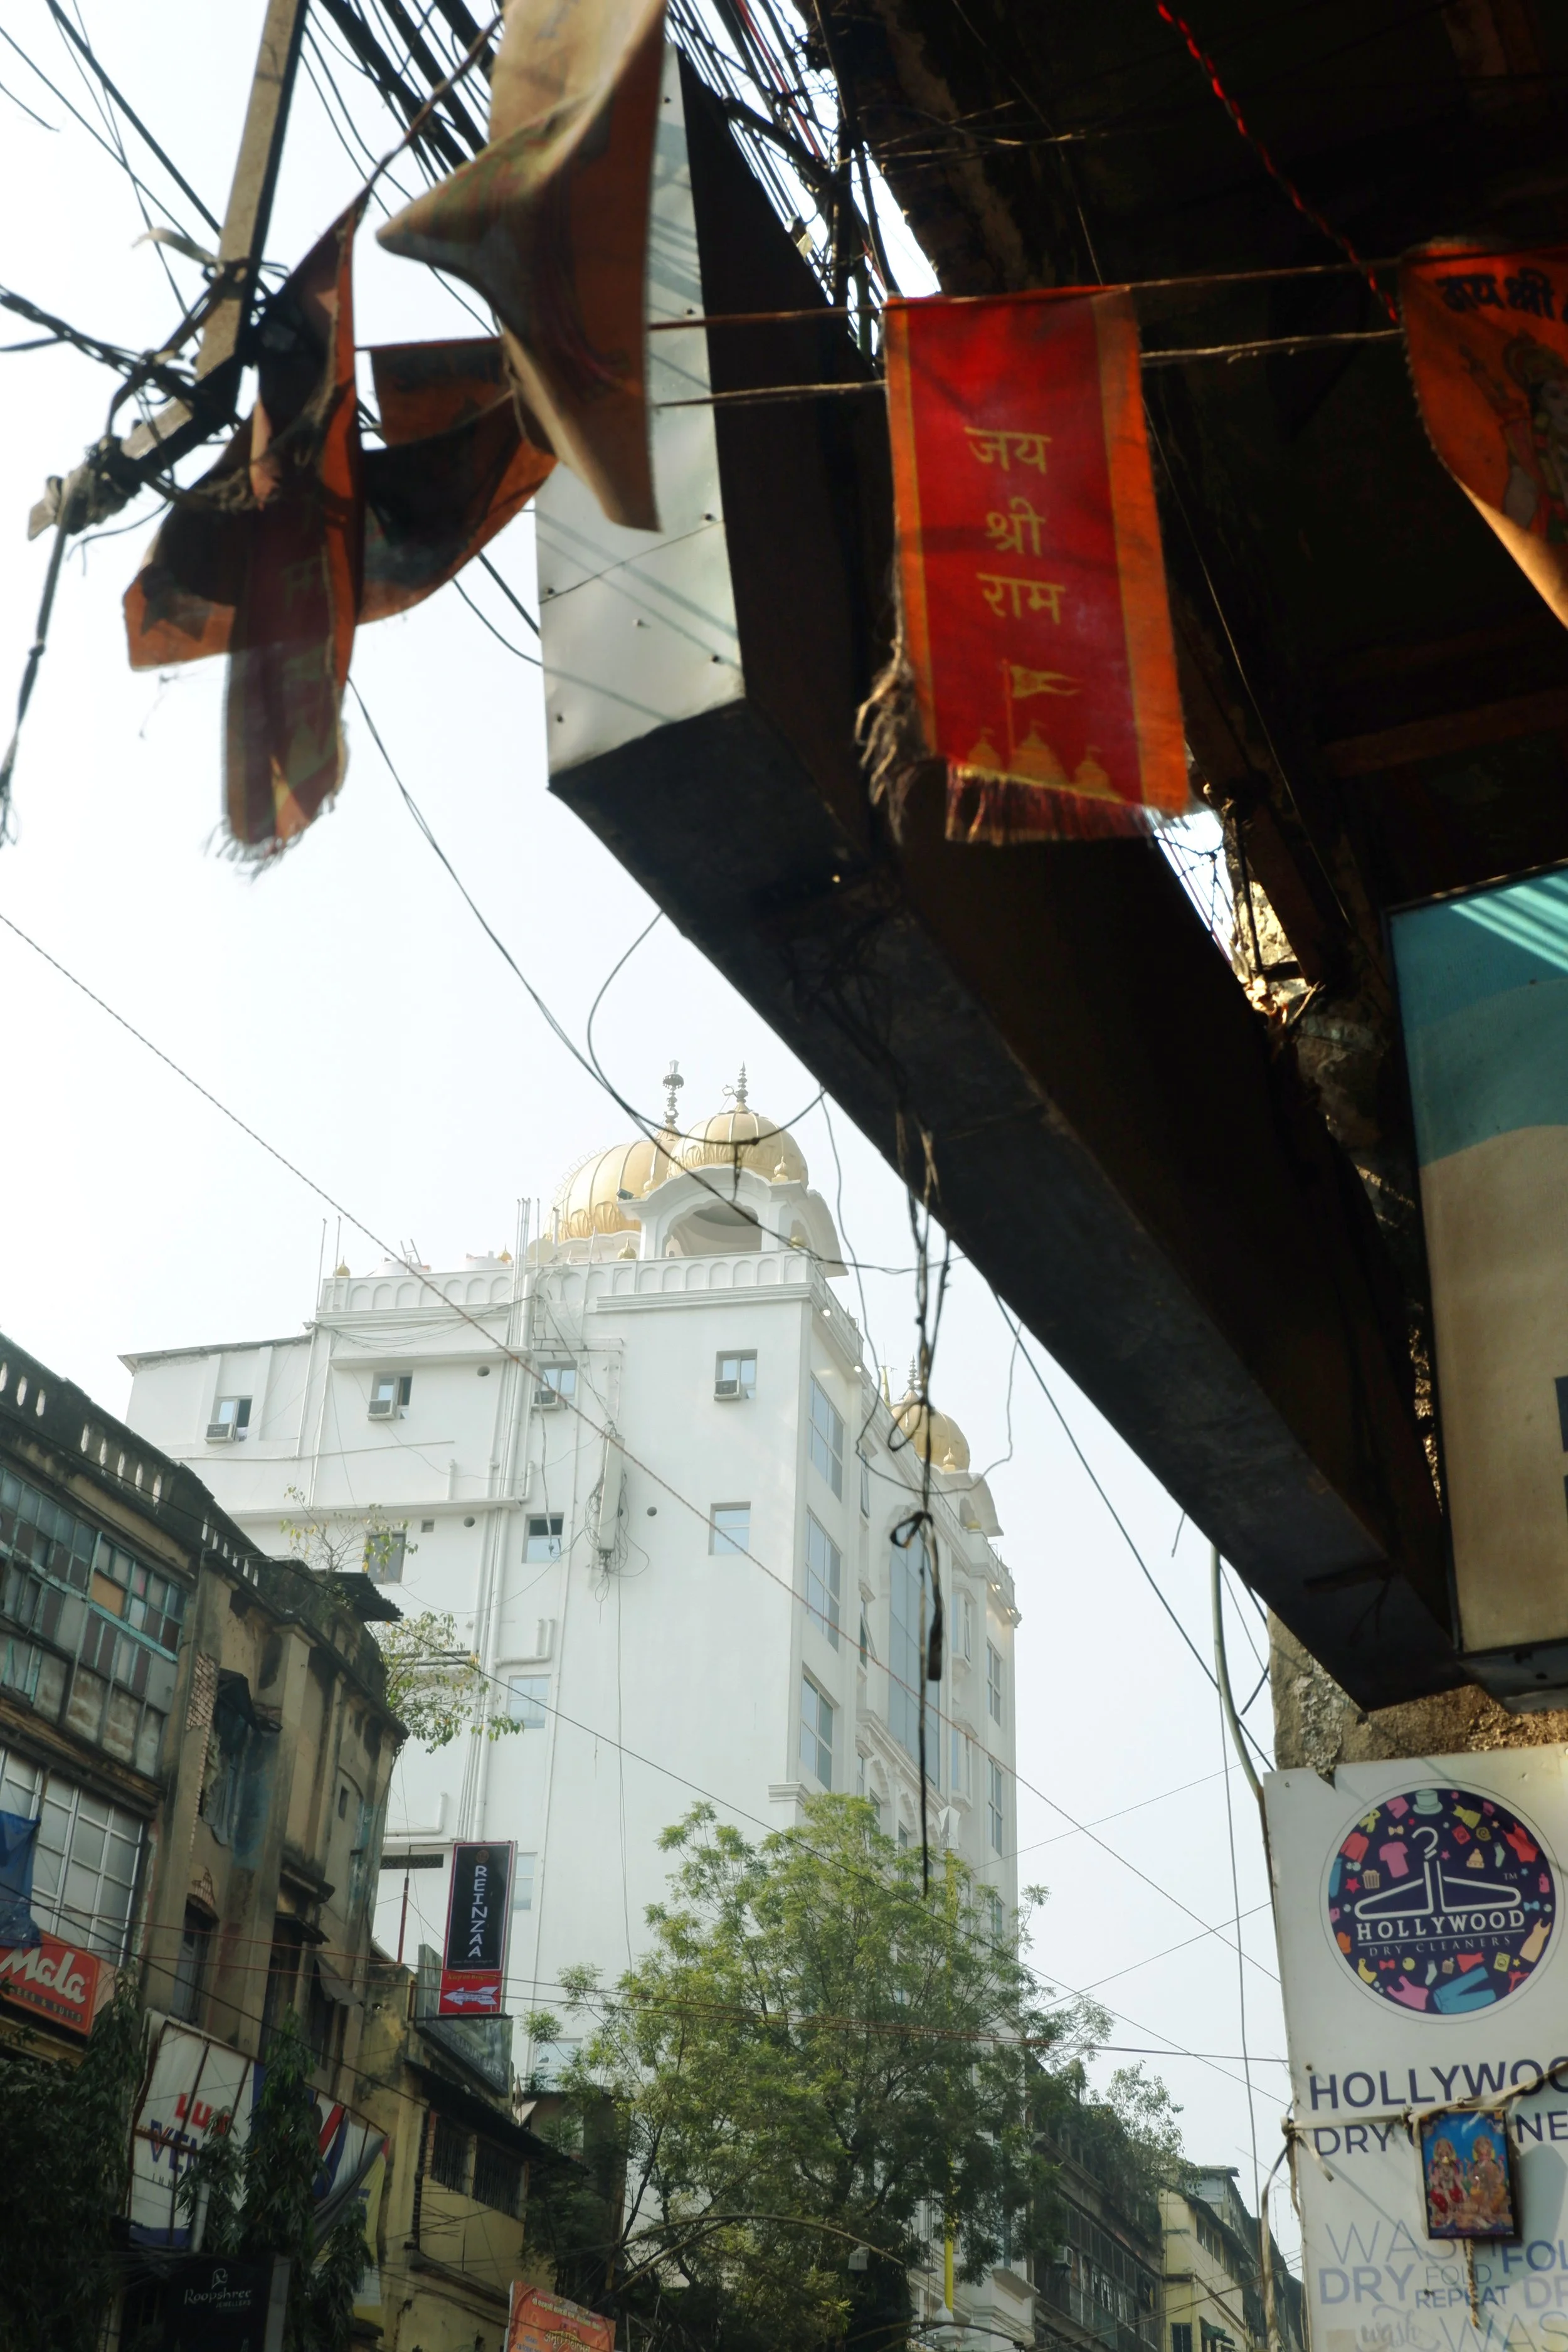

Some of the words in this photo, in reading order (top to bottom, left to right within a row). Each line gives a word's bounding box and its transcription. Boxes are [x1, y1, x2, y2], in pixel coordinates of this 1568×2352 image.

[963, 426, 1052, 474] जय
[984, 497, 1046, 558] श्री
[976, 572, 1066, 625] राम
[467, 1865, 488, 1957] REINZAA
[1356, 1910, 1525, 1941] HOLLYWOOD
[1369, 1945, 1403, 1956] DRY
[1416, 1936, 1510, 1952] CLEANERS
[0, 1946, 85, 2004] Mala
[1313, 2122, 1394, 2156] DRY
[183, 2287, 252, 2305] Roopshree
[1319, 2264, 1415, 2304] DRY
[1426, 2263, 1492, 2286] FOLD
